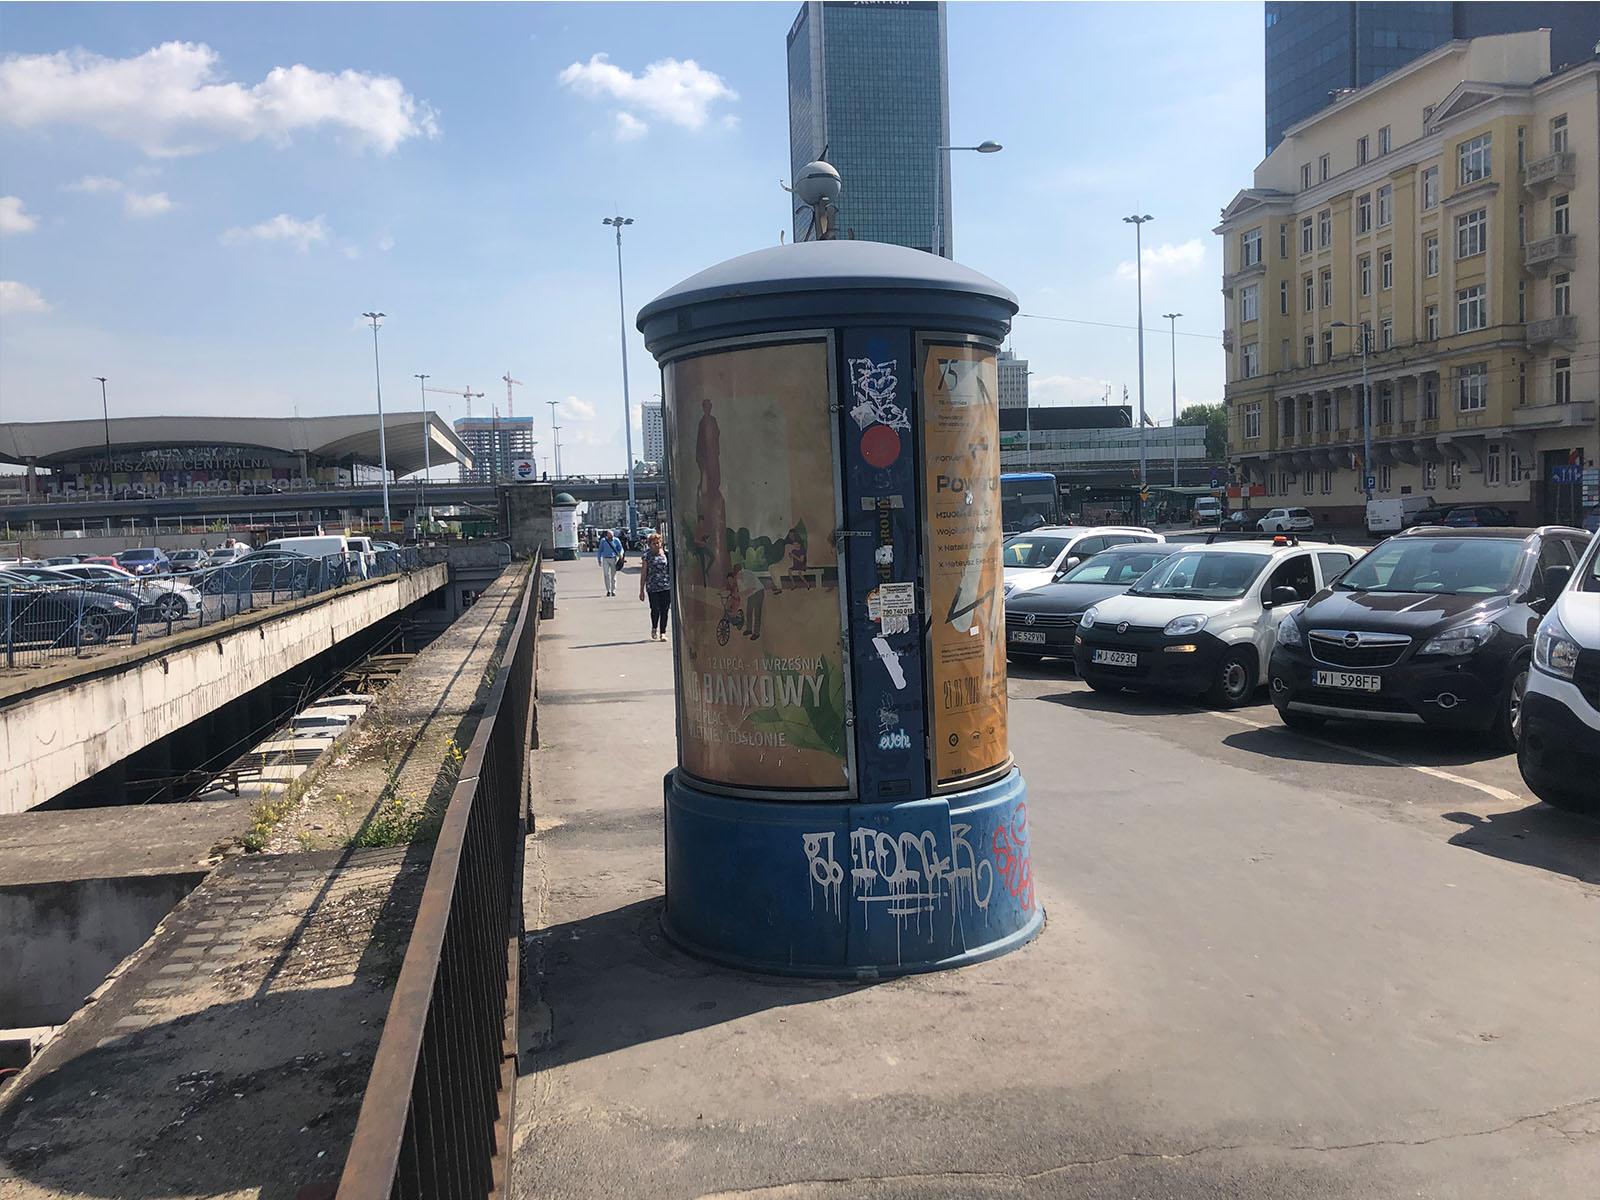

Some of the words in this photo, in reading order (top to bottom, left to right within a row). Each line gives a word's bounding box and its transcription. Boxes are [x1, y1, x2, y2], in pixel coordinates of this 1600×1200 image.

[90, 458, 175, 473] WARSZAWA
[183, 457, 271, 471] CENTRALNA
[719, 657, 744, 671] LIPCA
[762, 655, 824, 671] WRZEŚNIA
[1110, 652, 1137, 664] 6293C
[1318, 671, 1334, 685] WI
[1340, 674, 1379, 689] 598FF
[703, 671, 825, 708] BANKOWY
